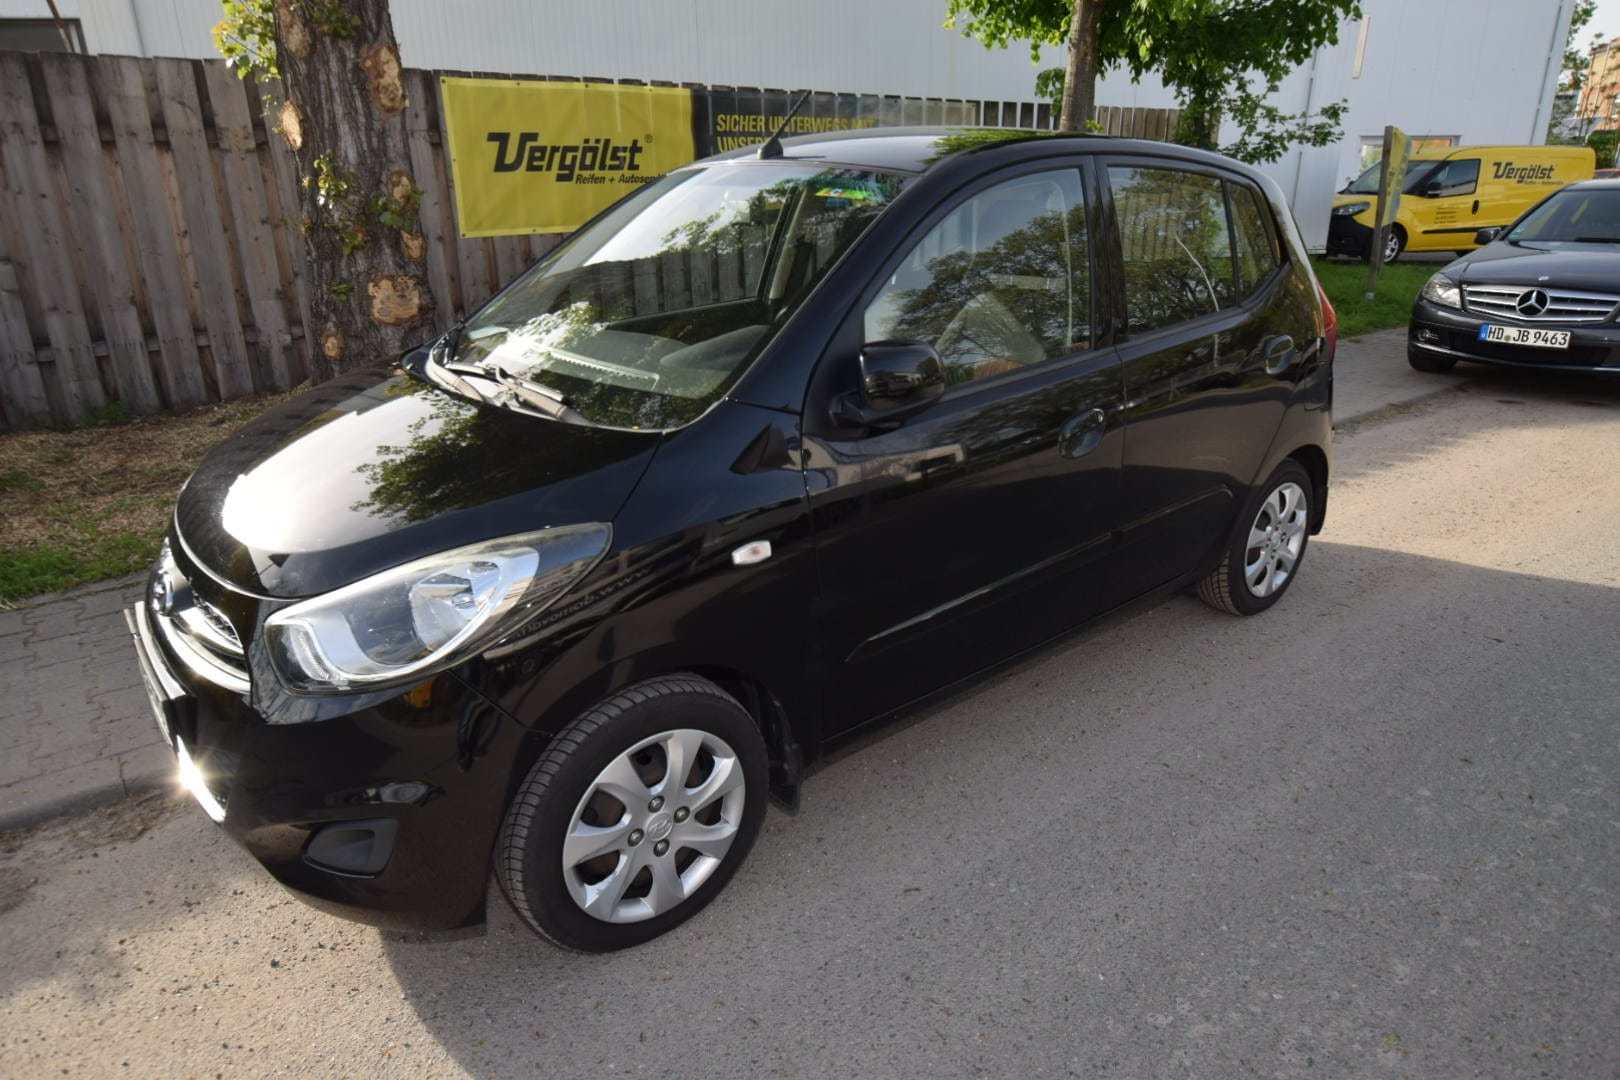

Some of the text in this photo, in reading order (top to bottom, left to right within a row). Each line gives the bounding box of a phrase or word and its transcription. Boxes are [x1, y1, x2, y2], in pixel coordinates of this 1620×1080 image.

[716, 113, 765, 132] SICHER
[486, 132, 643, 182] Vergölst
[575, 173, 605, 185] Reifen
[1493, 161, 1554, 184] Vergölst
[1488, 326, 1505, 340] HD
[1513, 329, 1530, 343] JB
[1533, 331, 1569, 346] 9463
